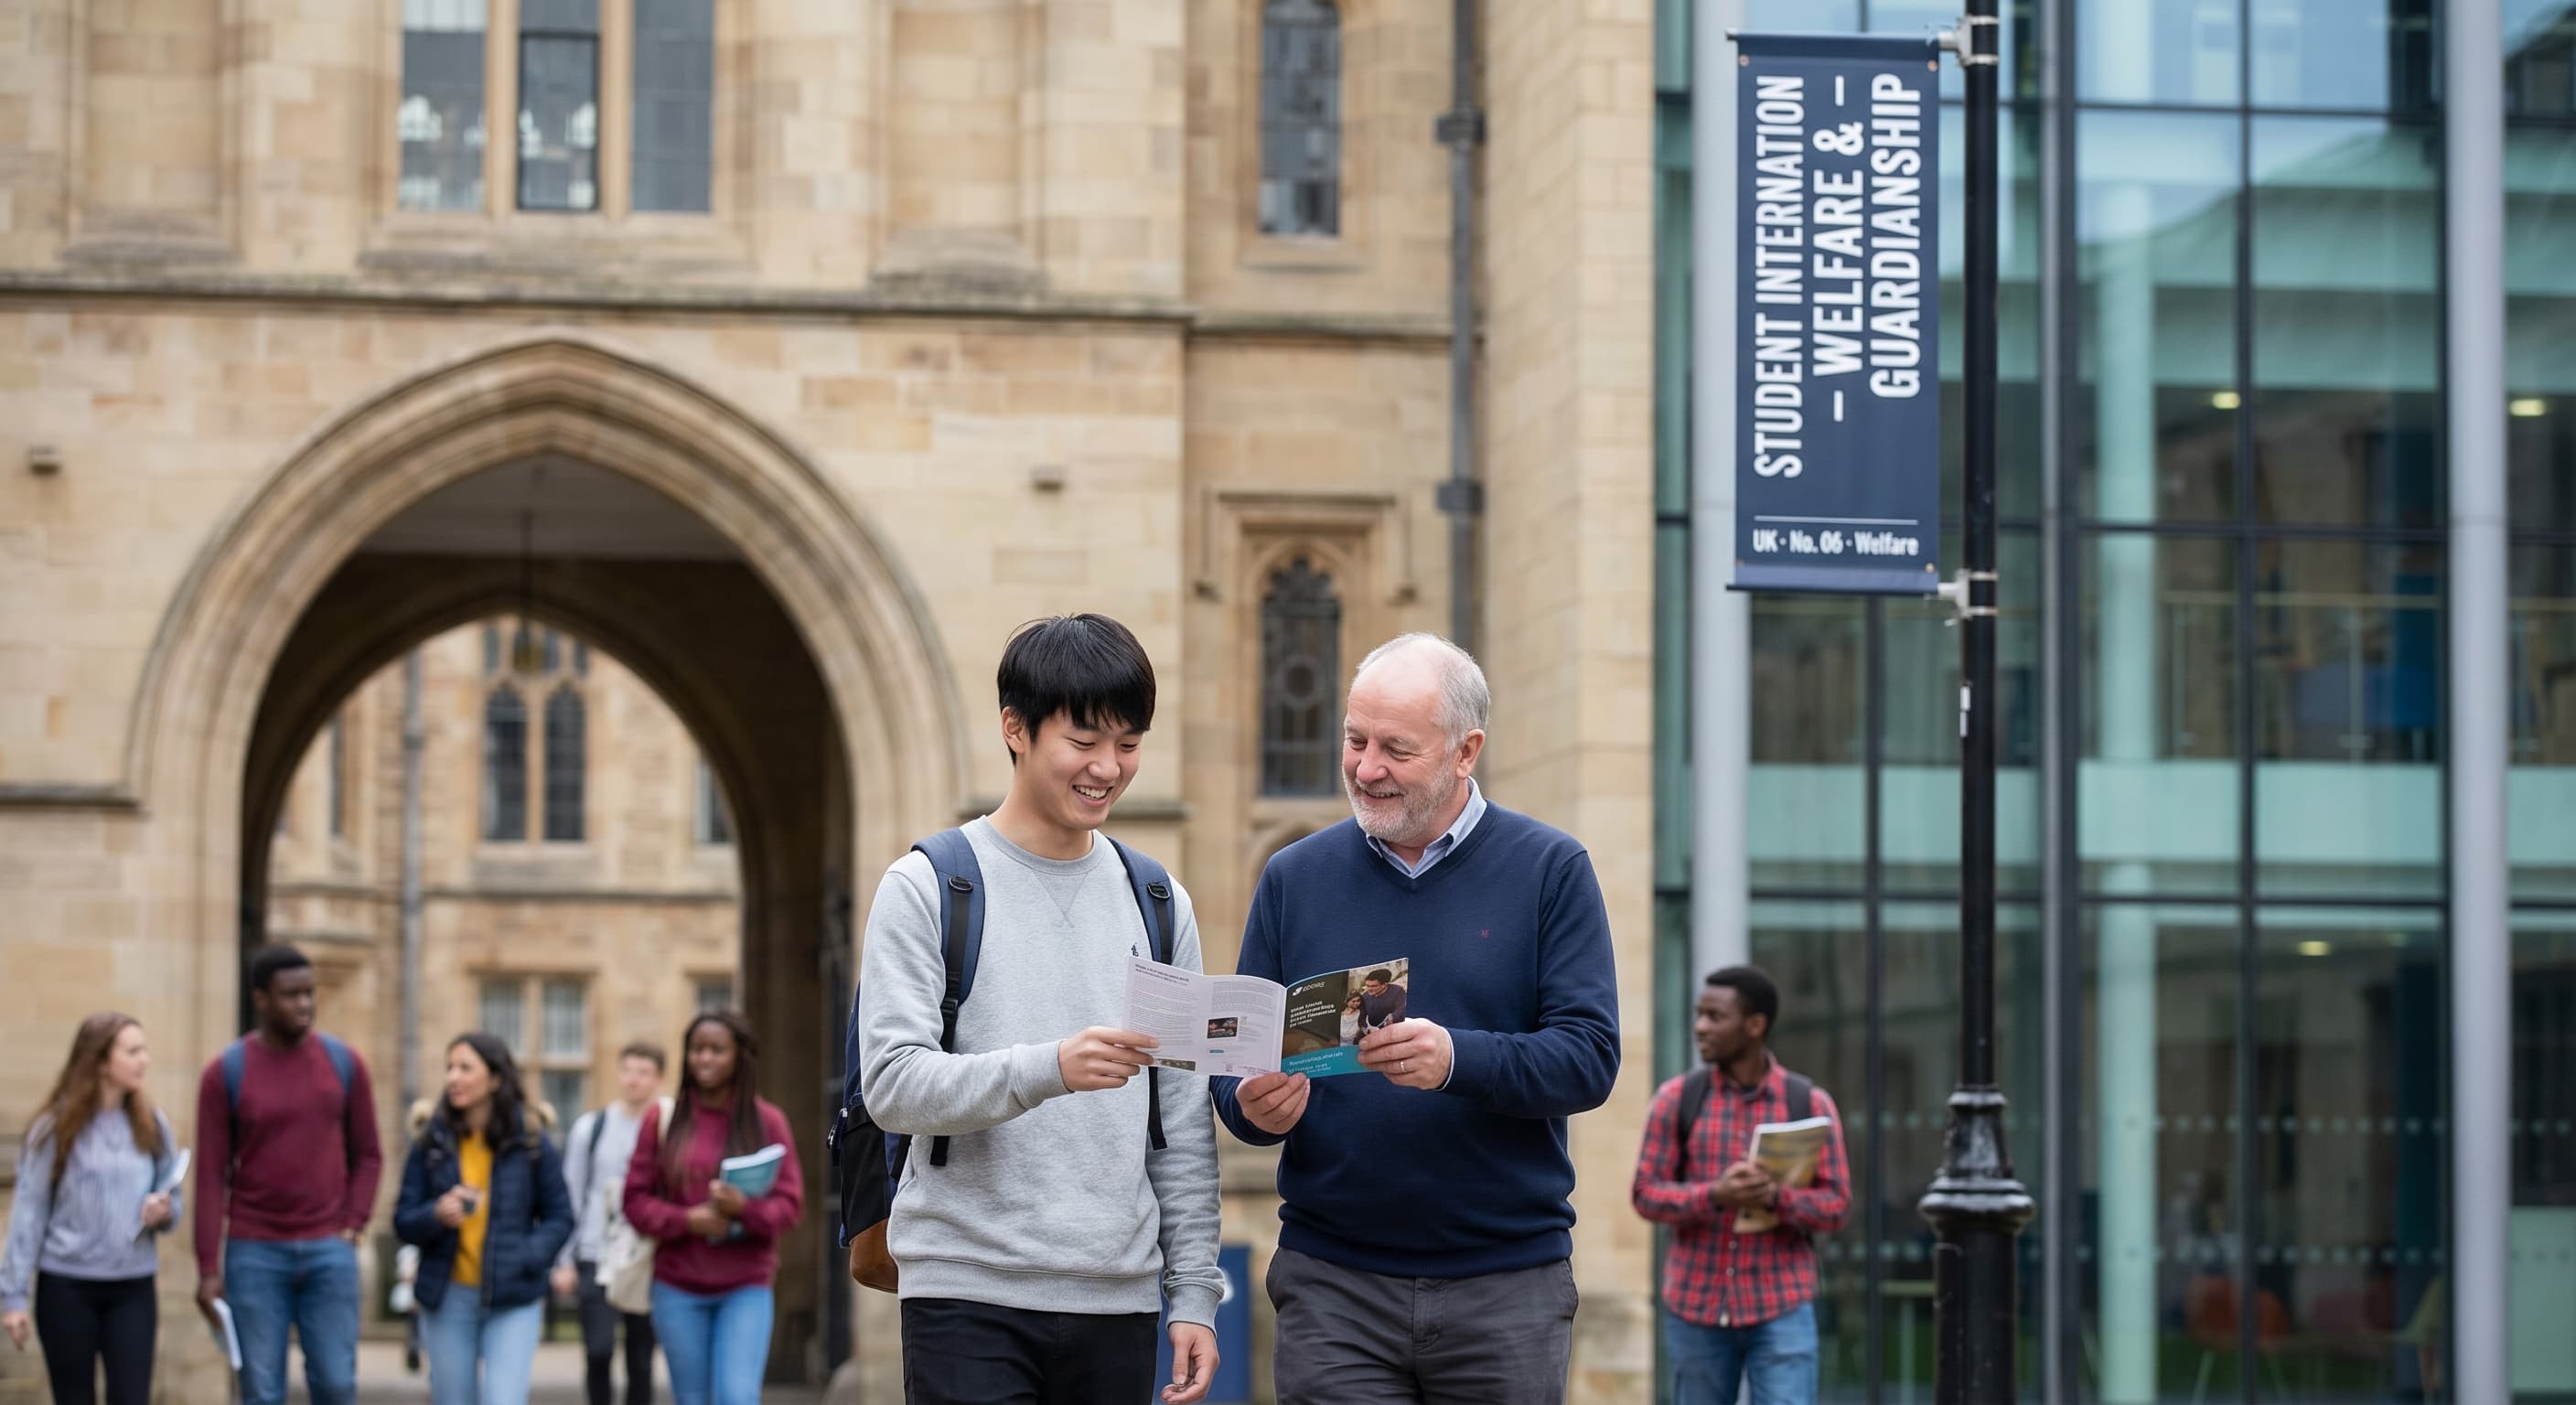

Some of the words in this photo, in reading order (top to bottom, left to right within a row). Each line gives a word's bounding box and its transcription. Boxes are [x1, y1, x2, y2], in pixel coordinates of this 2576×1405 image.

[1755, 75, 1805, 305] INTERNATION
[1812, 121, 1864, 156] &
[1812, 169, 1864, 377] WELFARE
[1869, 72, 1921, 399] GUARDIANSHIP
[1754, 312, 1804, 478] STUDENT
[1753, 529, 1778, 552] UK
[1789, 530, 1819, 554] No.
[1819, 530, 1844, 554] 06
[1853, 531, 1919, 556] Welfare
